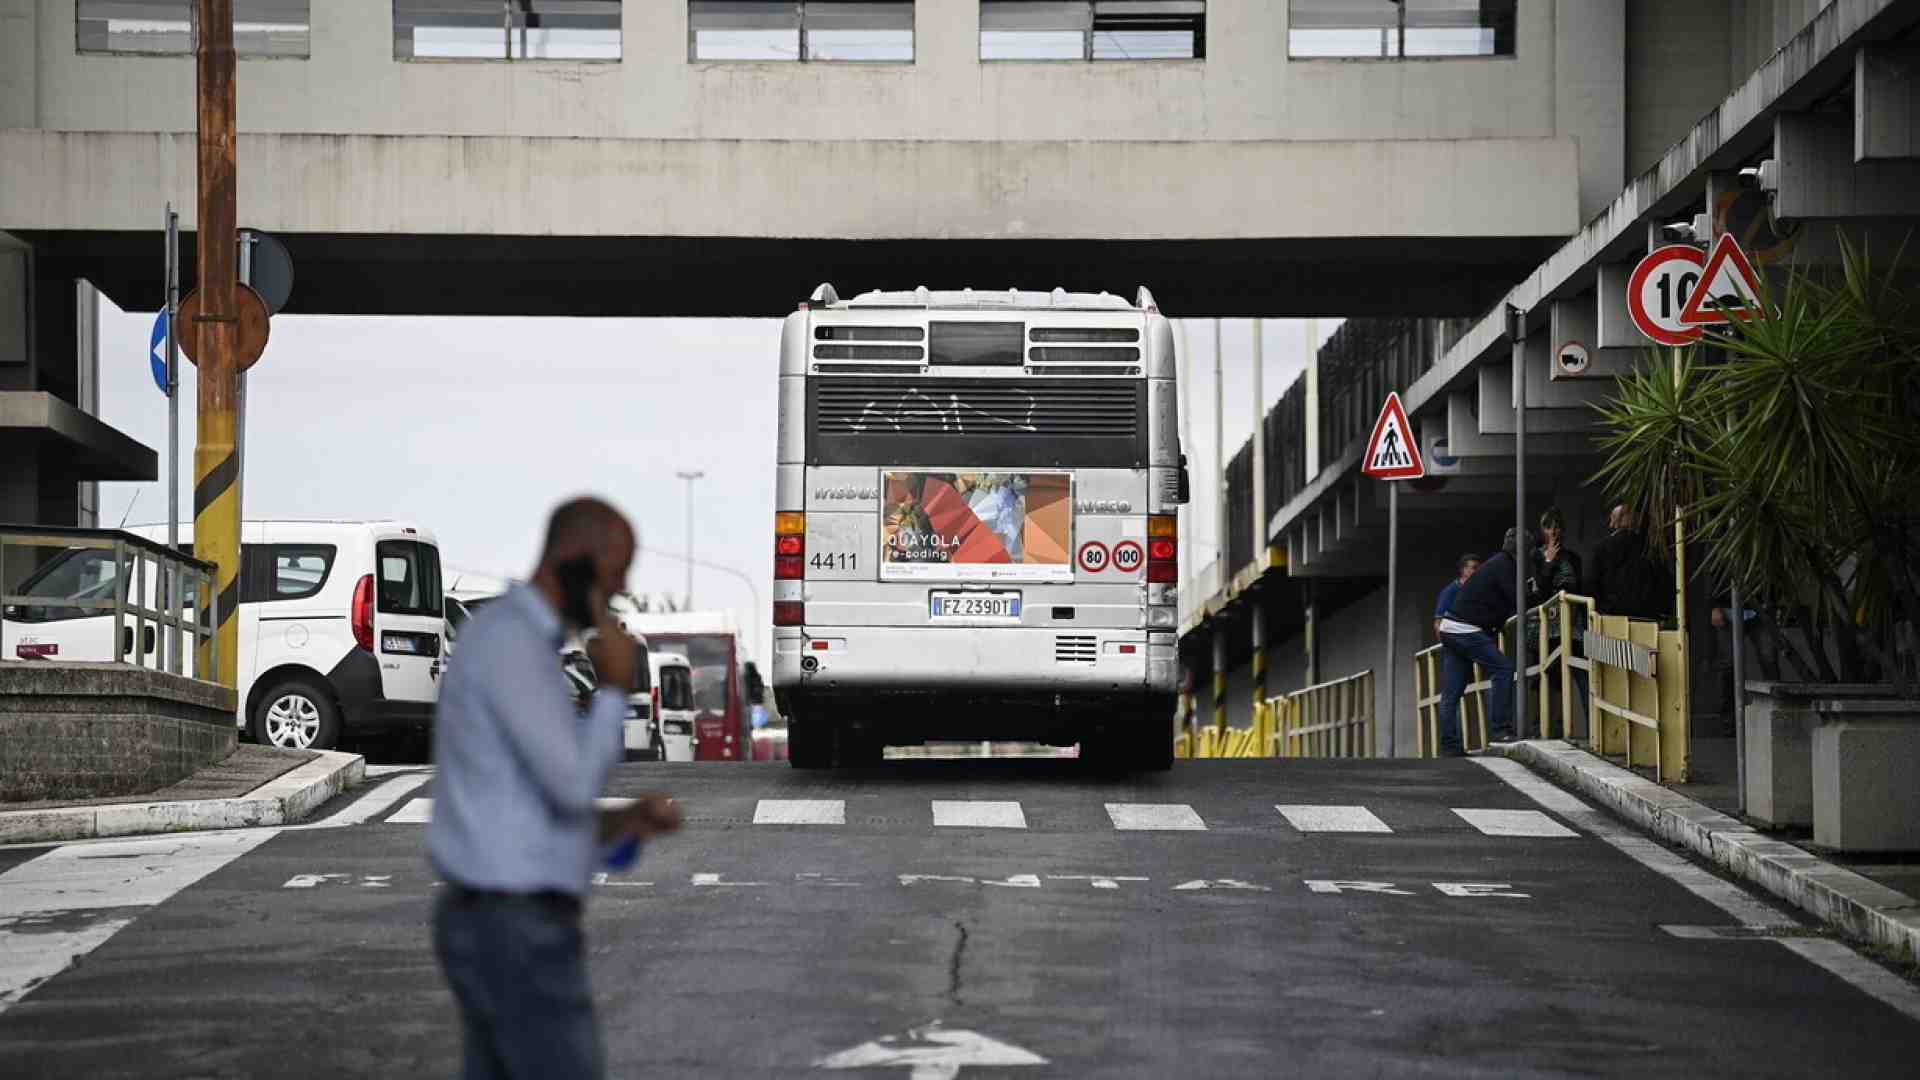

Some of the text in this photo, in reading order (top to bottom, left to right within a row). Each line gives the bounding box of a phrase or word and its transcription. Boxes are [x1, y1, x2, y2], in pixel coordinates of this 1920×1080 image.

[1656, 272, 1700, 318] 10
[888, 534, 961, 546] QUAYOLA
[810, 552, 857, 570] 4411
[1086, 550, 1102, 563] 80
[1118, 550, 1138, 563] 100
[943, 599, 961, 614] FZ
